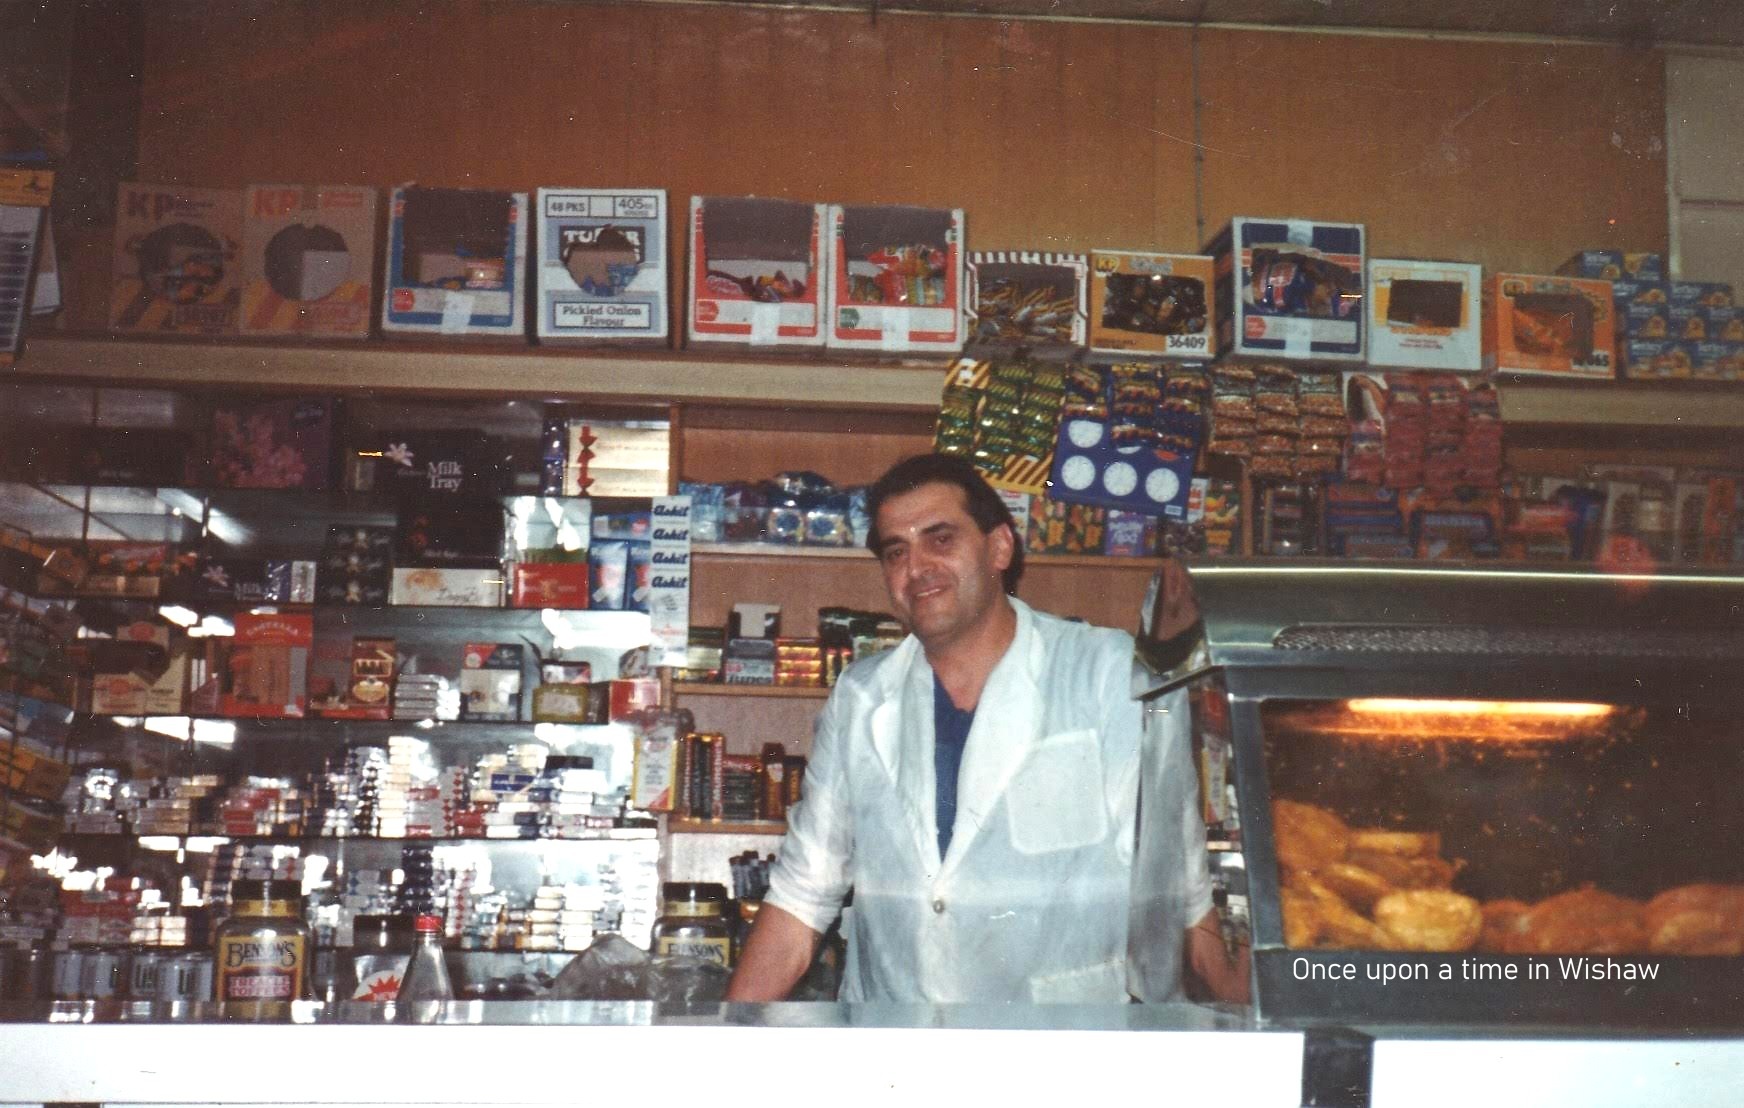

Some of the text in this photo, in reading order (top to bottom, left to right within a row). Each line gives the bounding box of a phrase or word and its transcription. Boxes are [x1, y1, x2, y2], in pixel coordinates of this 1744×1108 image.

[550, 202, 586, 212] 48 PKS
[563, 227, 641, 246] TUR
[562, 305, 642, 315] Pickled Onion
[583, 315, 625, 327] Flavour
[1168, 335, 1206, 349] 36409
[427, 460, 463, 478] Milk
[429, 475, 463, 492] Tray
